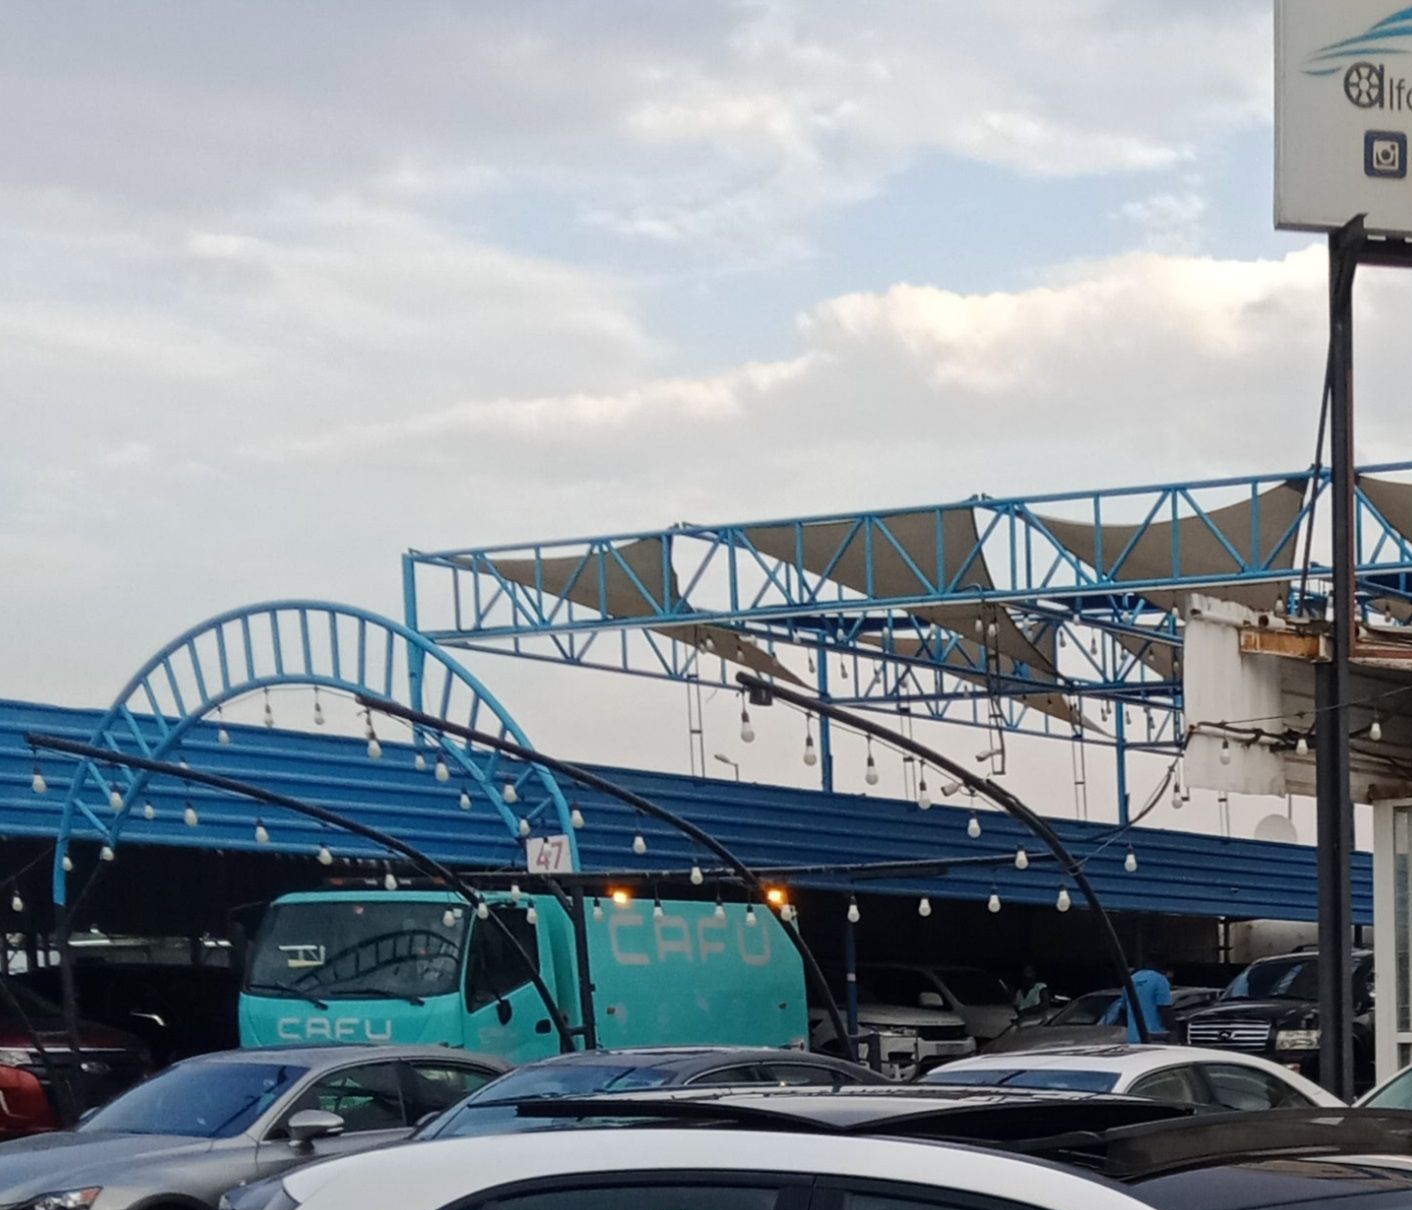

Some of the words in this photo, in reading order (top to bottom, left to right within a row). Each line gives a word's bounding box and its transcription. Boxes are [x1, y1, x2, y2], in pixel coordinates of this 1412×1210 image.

[535, 840, 564, 871] 47
[607, 908, 773, 967] CAFU
[277, 1016, 393, 1040] CAFU
